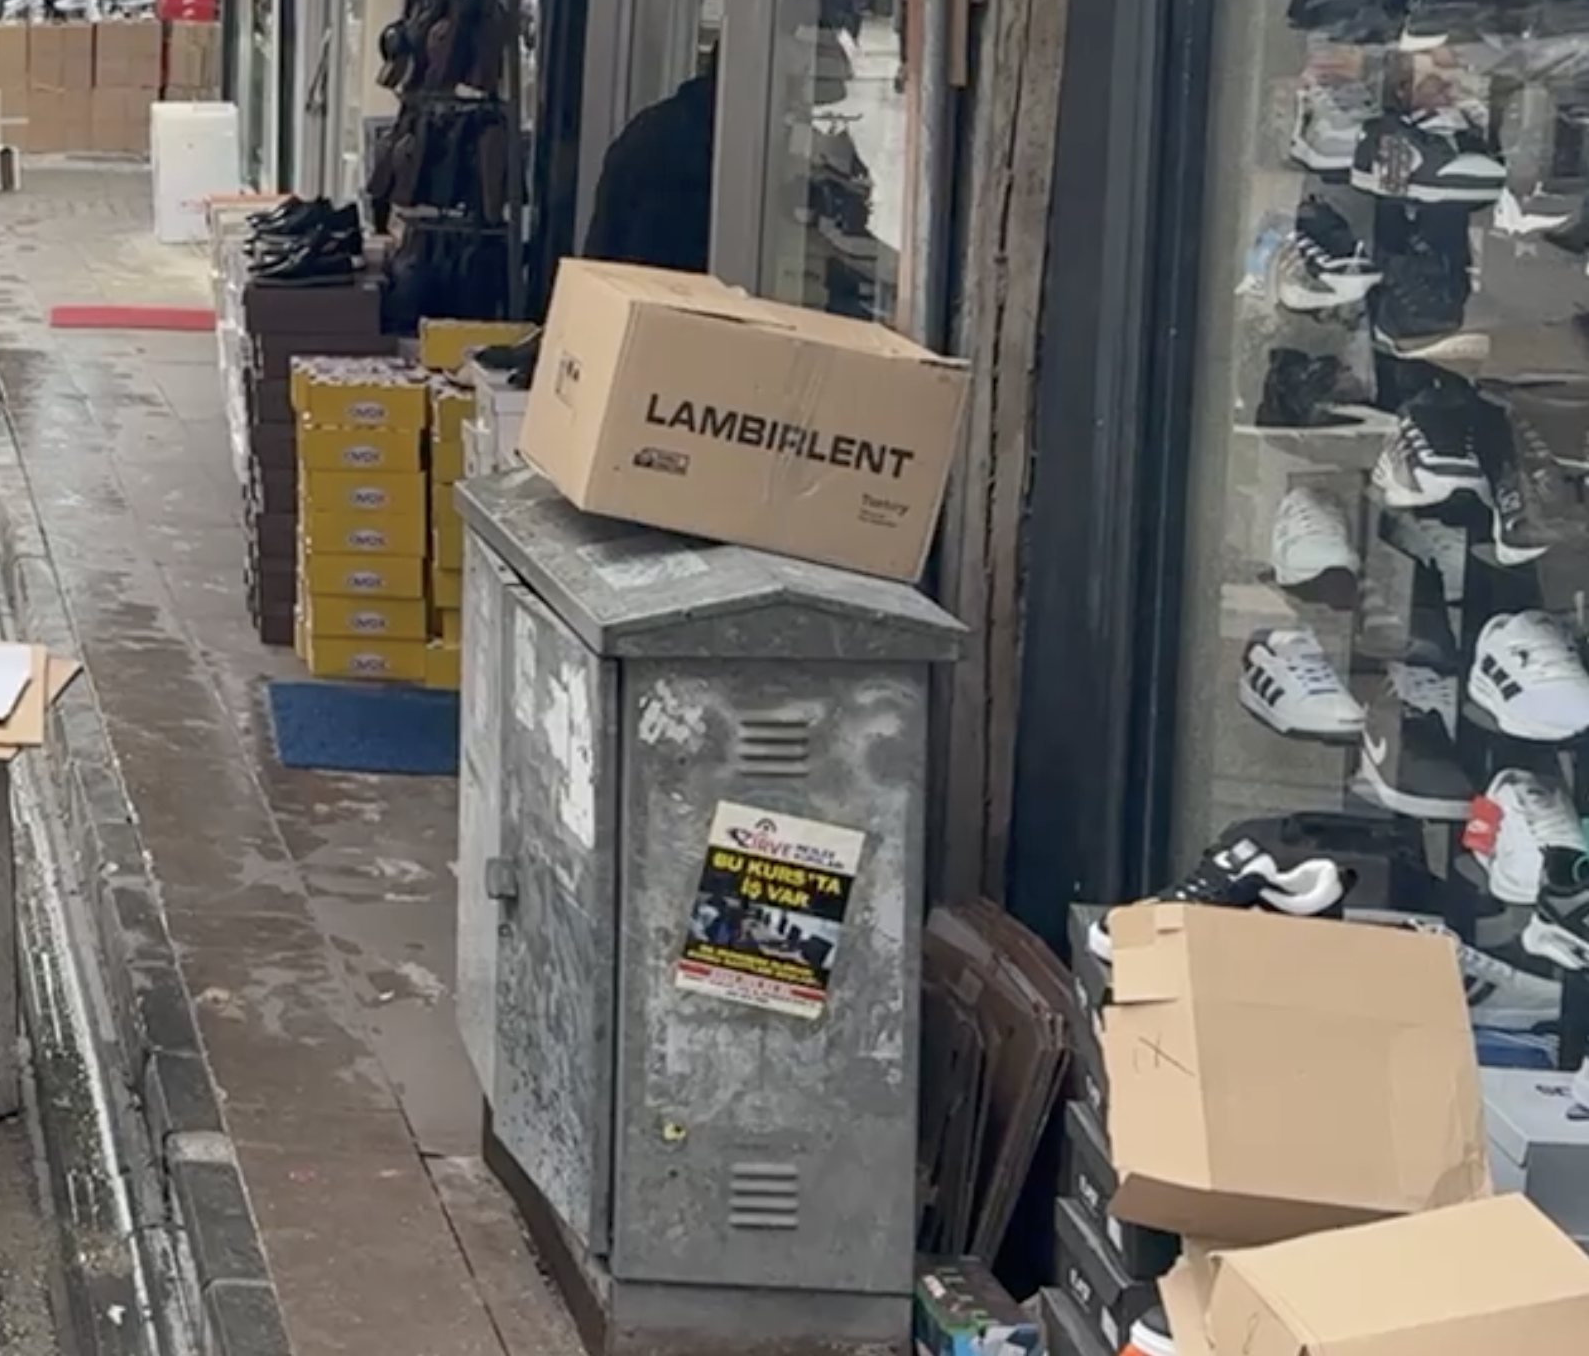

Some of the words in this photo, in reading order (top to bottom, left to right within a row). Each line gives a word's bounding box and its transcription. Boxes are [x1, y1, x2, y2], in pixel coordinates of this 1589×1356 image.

[644, 393, 915, 479] LAMBIRLENT
[712, 852, 743, 871] BU
[748, 858, 805, 886] KURS
[766, 884, 810, 909] VAR
